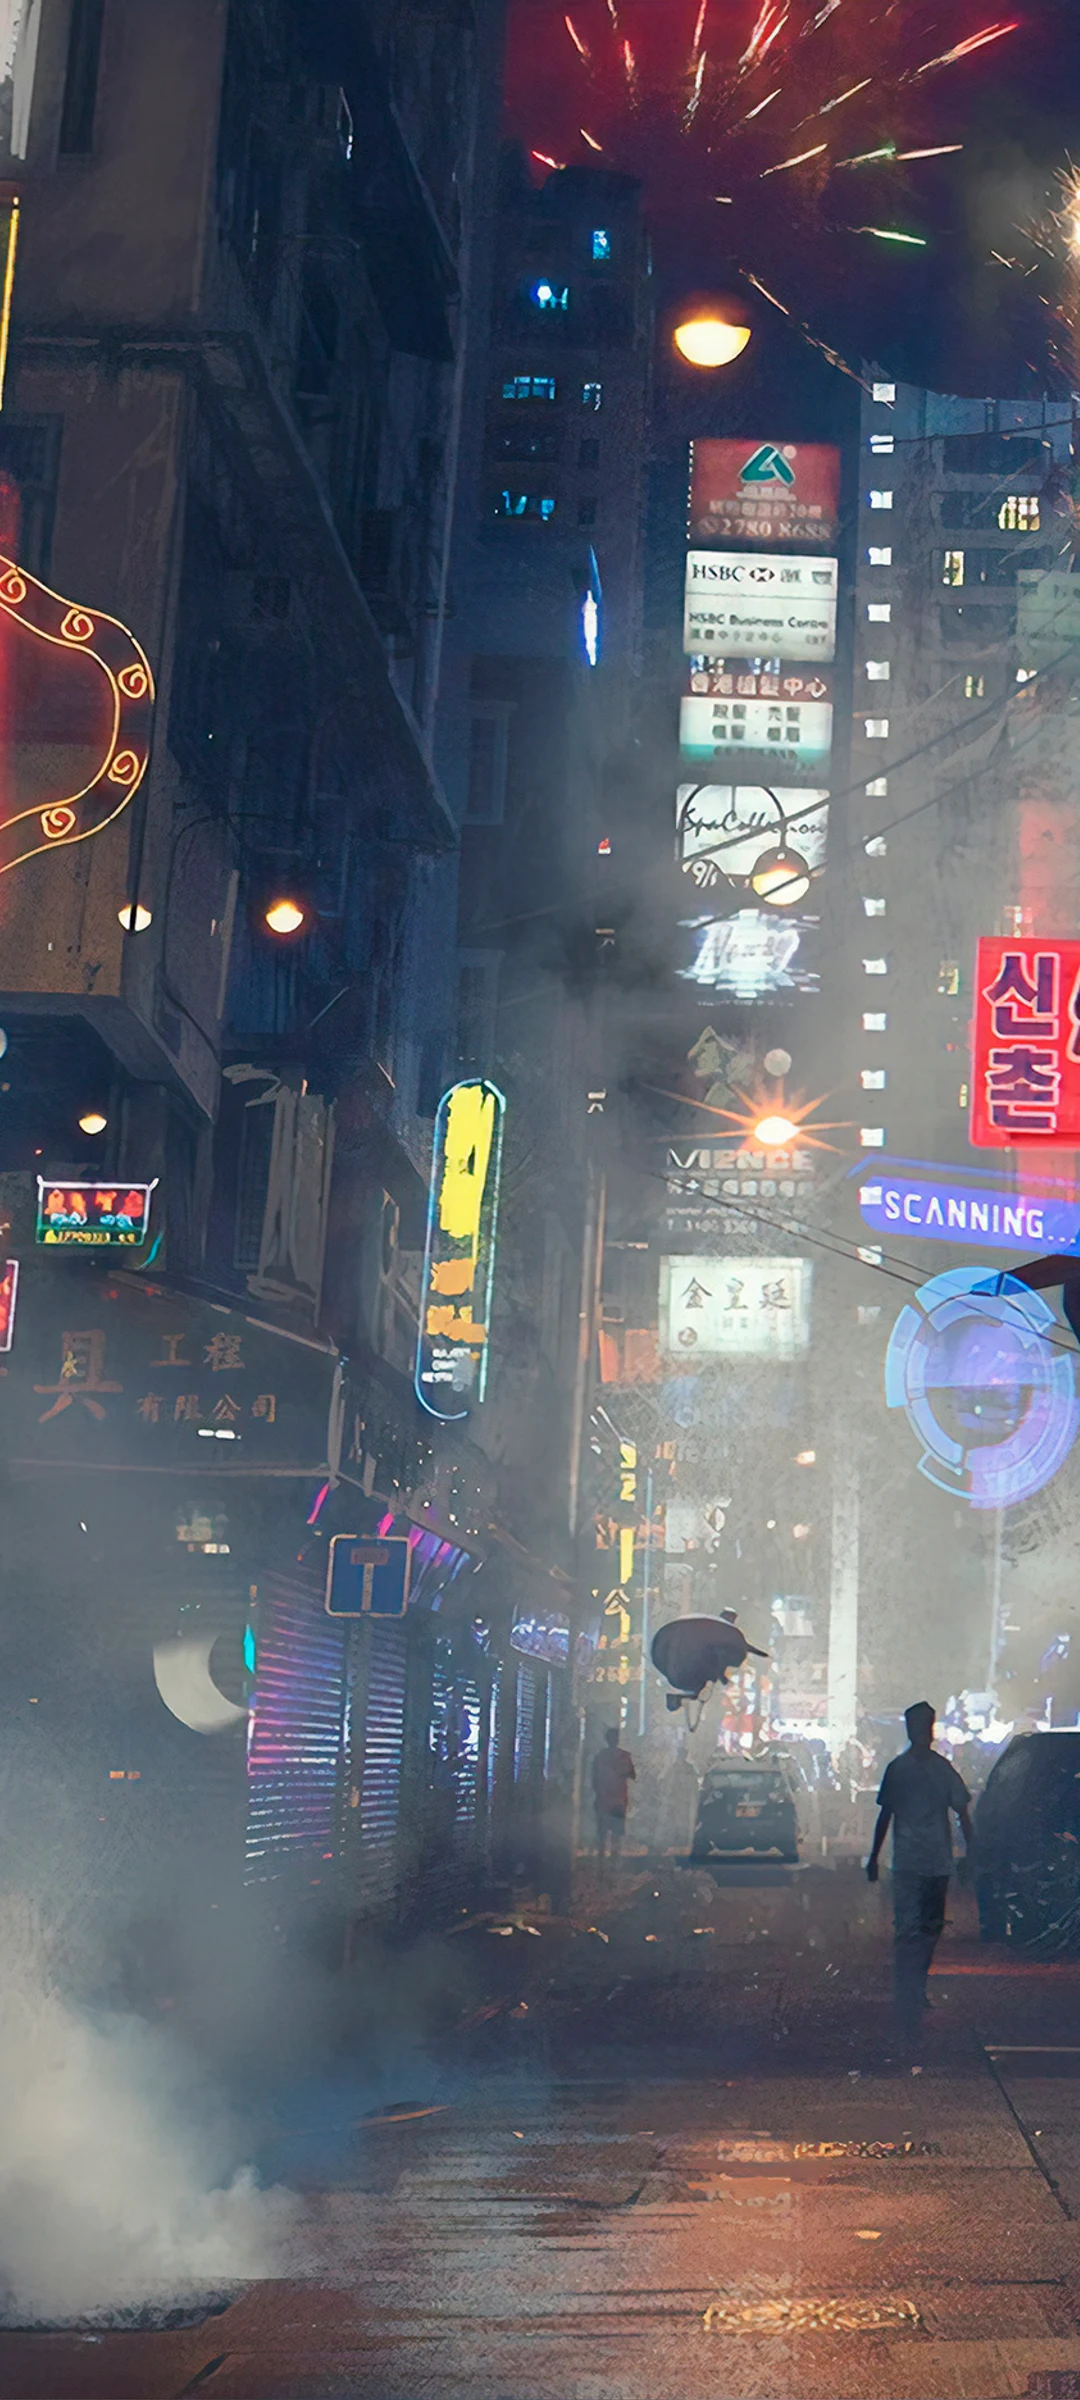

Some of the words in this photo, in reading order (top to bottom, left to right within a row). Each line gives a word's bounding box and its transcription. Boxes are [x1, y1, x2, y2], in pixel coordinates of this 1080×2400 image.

[692, 564, 746, 582] HSBC
[689, 612, 725, 625] HSBC
[982, 952, 1061, 1133] 신촌
